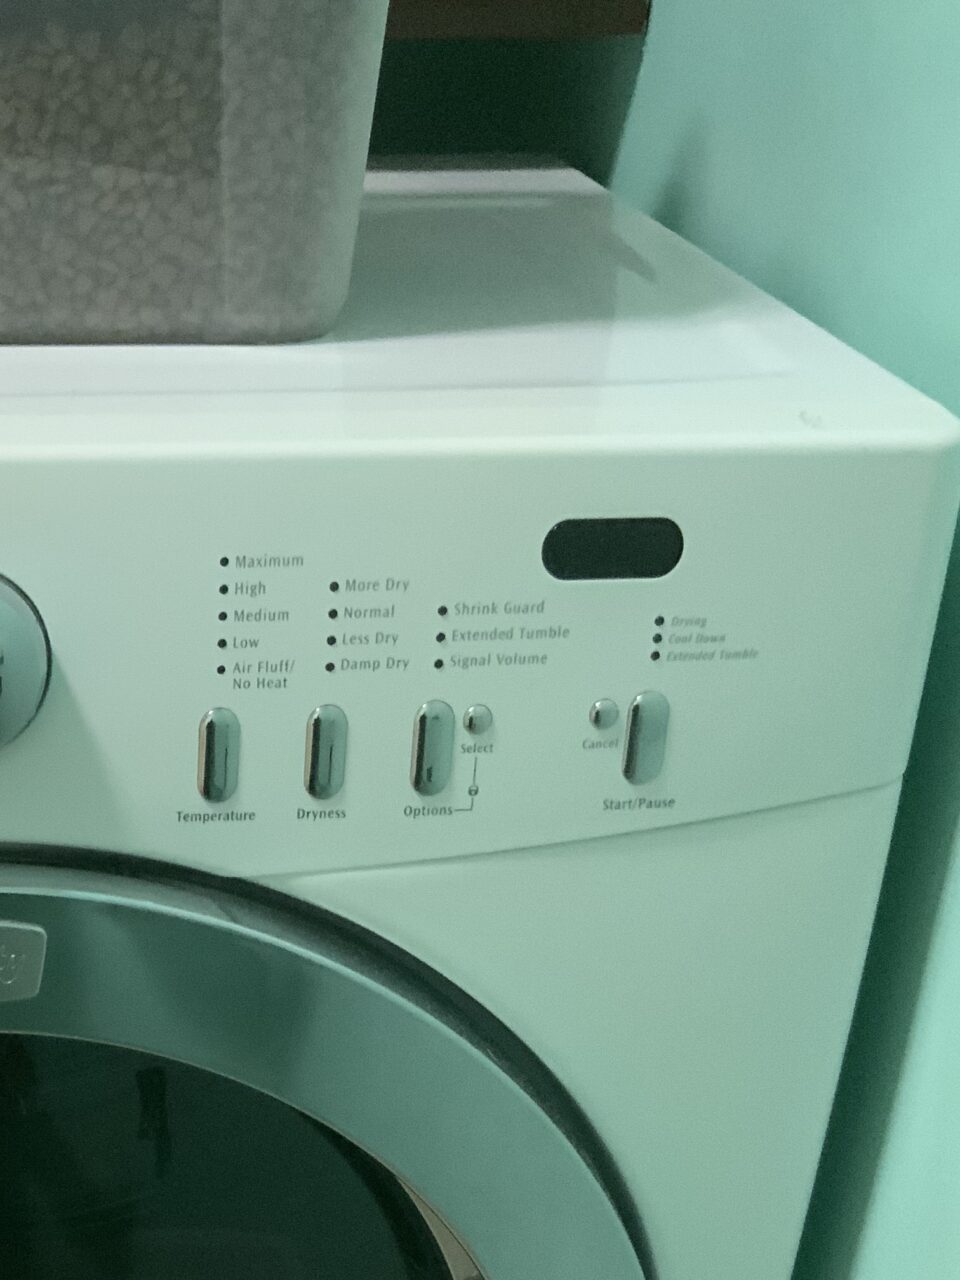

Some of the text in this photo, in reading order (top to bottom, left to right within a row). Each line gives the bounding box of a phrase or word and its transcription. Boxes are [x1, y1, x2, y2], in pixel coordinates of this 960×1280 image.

[235, 554, 304, 569] Maximum
[234, 582, 266, 598] High
[345, 578, 410, 593] More Dry
[233, 609, 290, 622] Medium
[343, 605, 395, 619] Normal
[453, 600, 545, 616] Shrink Guard
[342, 632, 400, 647] Less Dry
[451, 625, 570, 642] Extended Tumble
[233, 636, 260, 649] Low
[233, 659, 295, 674] Air Fluff/
[340, 656, 410, 672] Damp Dry
[449, 652, 548, 669] Signal Volume
[233, 676, 288, 690] No Heat
[460, 742, 494, 754] Select
[582, 738, 620, 750] Cancel
[602, 796, 676, 811] Start/Pause
[176, 810, 256, 825] Temperature
[297, 807, 346, 822] Dryness
[403, 804, 453, 820] Options
